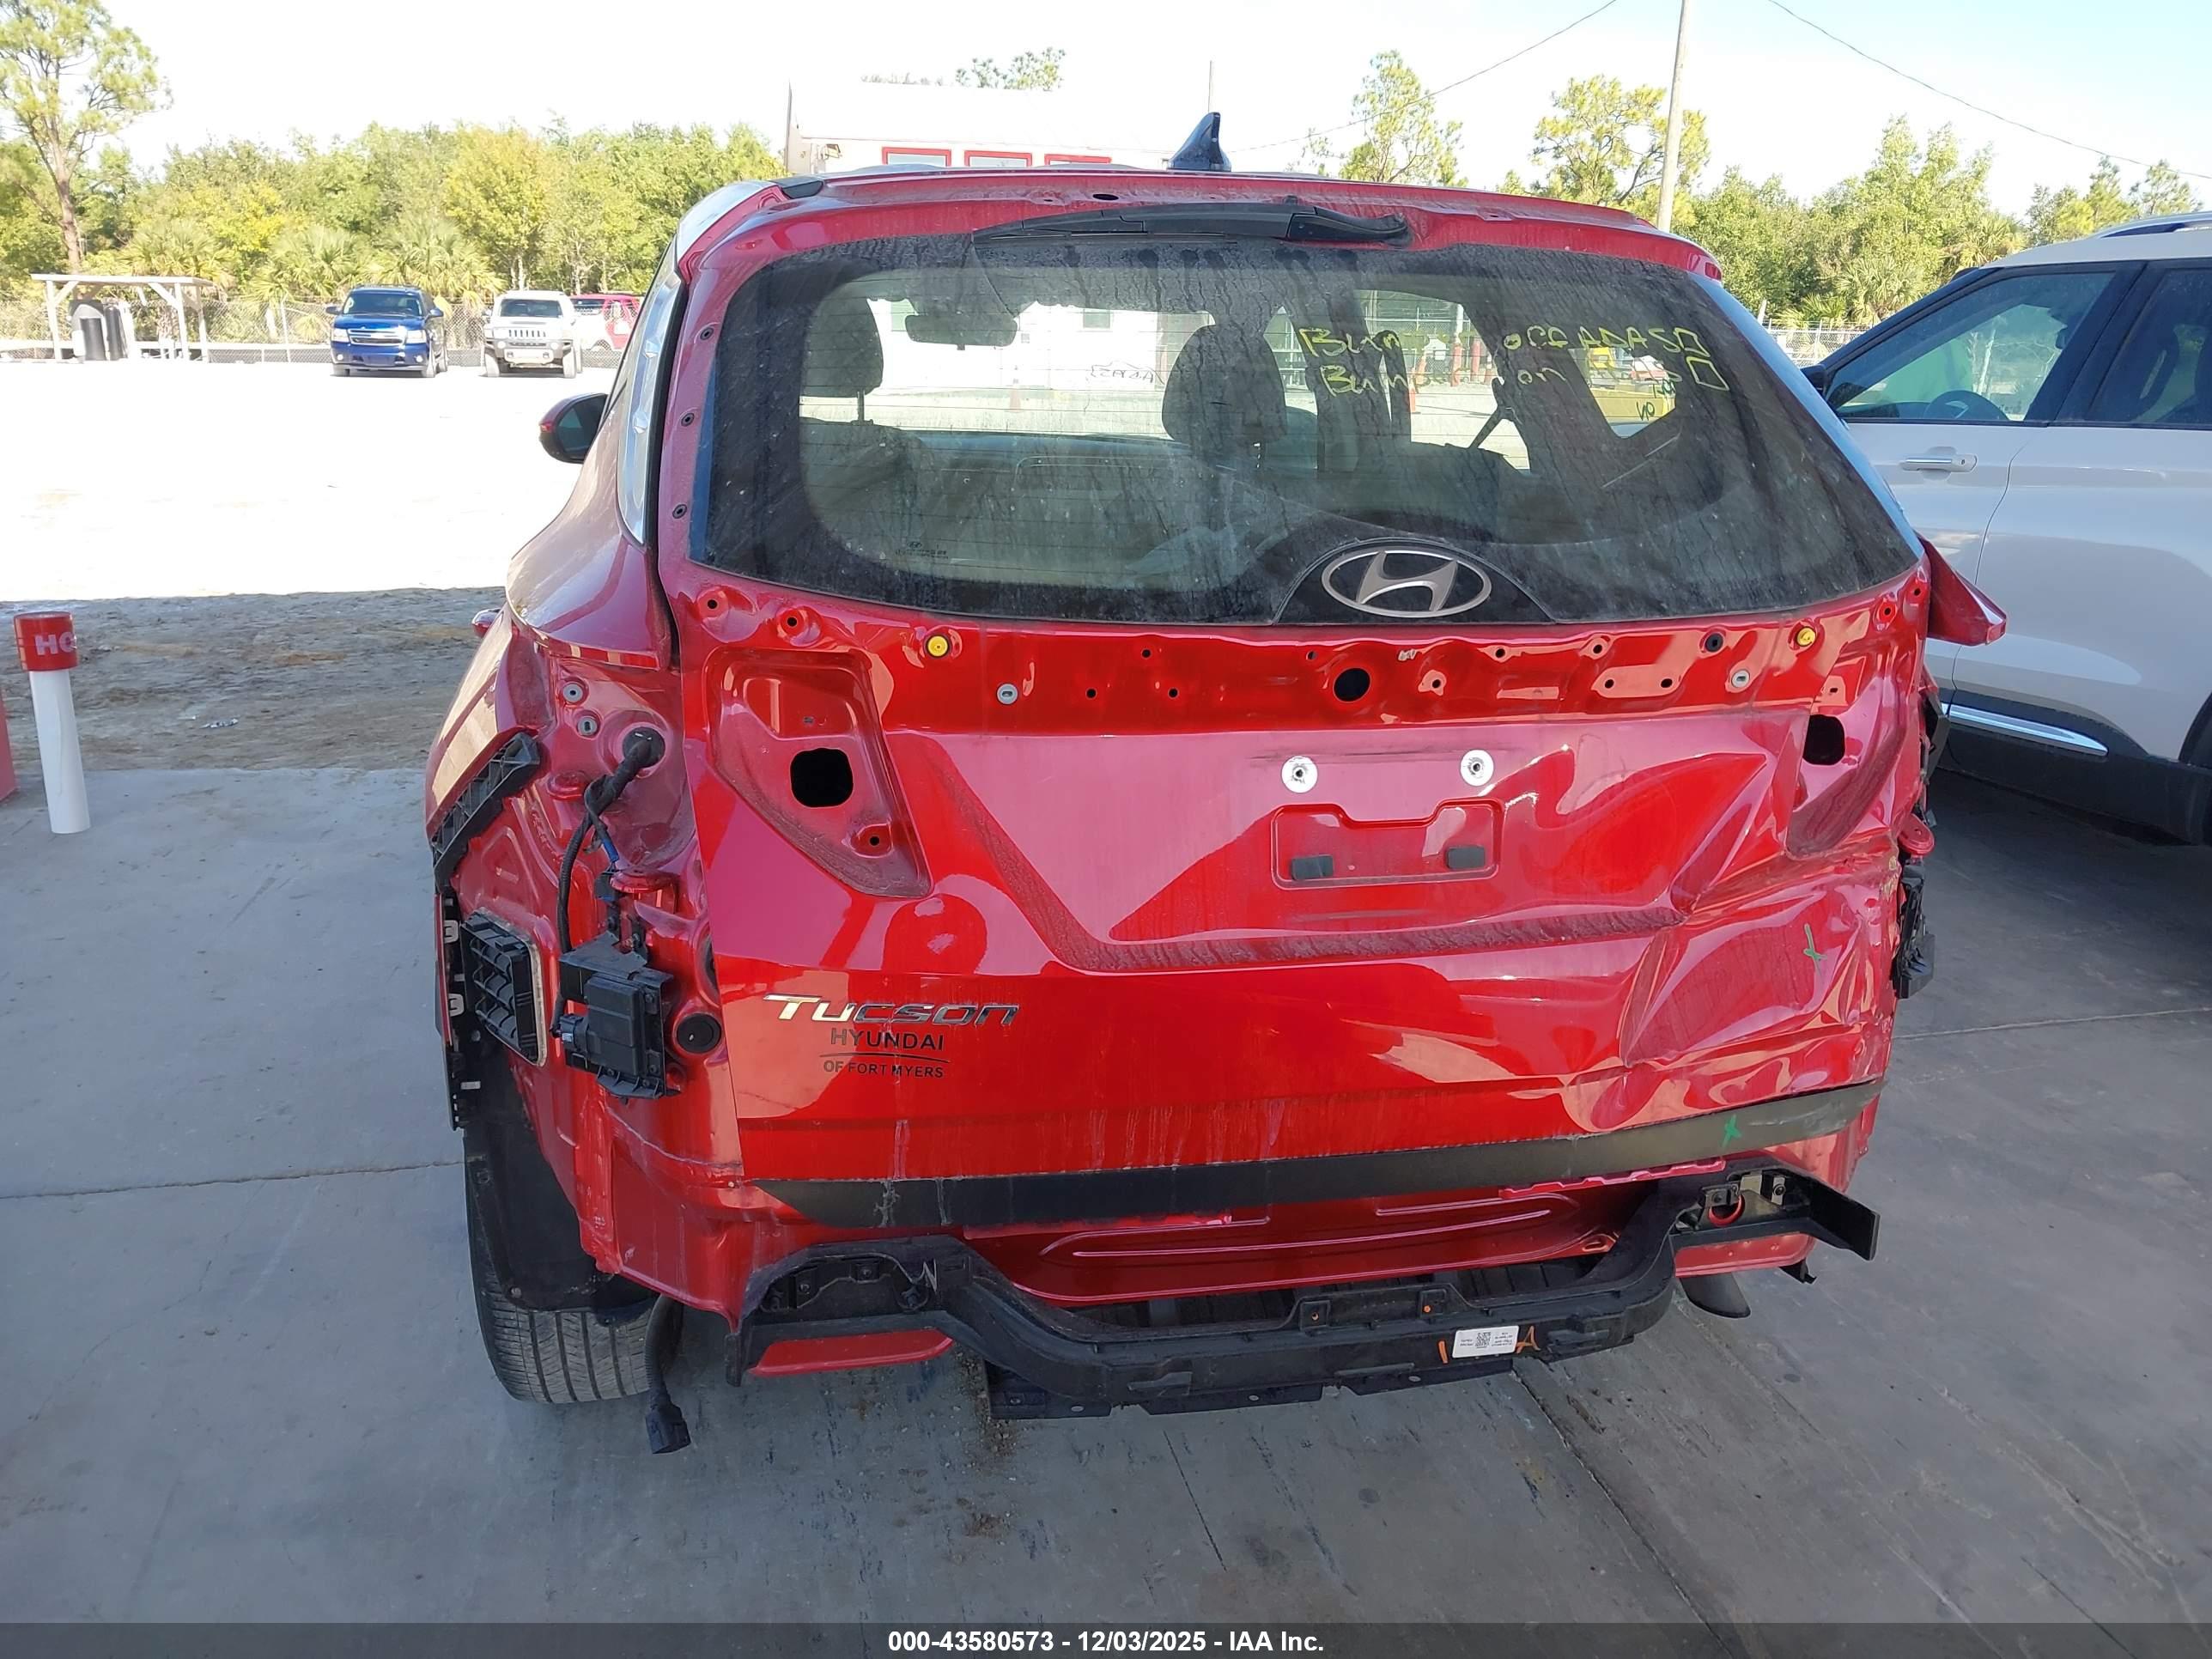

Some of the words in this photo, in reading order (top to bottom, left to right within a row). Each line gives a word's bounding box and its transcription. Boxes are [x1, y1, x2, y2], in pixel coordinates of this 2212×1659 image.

[1577, 325, 1682, 353] ADAS
[830, 1027, 945, 1053] HYUNDAI
[823, 1060, 844, 1073] OF
[848, 1062, 888, 1076] FORT
[891, 1065, 944, 1079] MYERS
